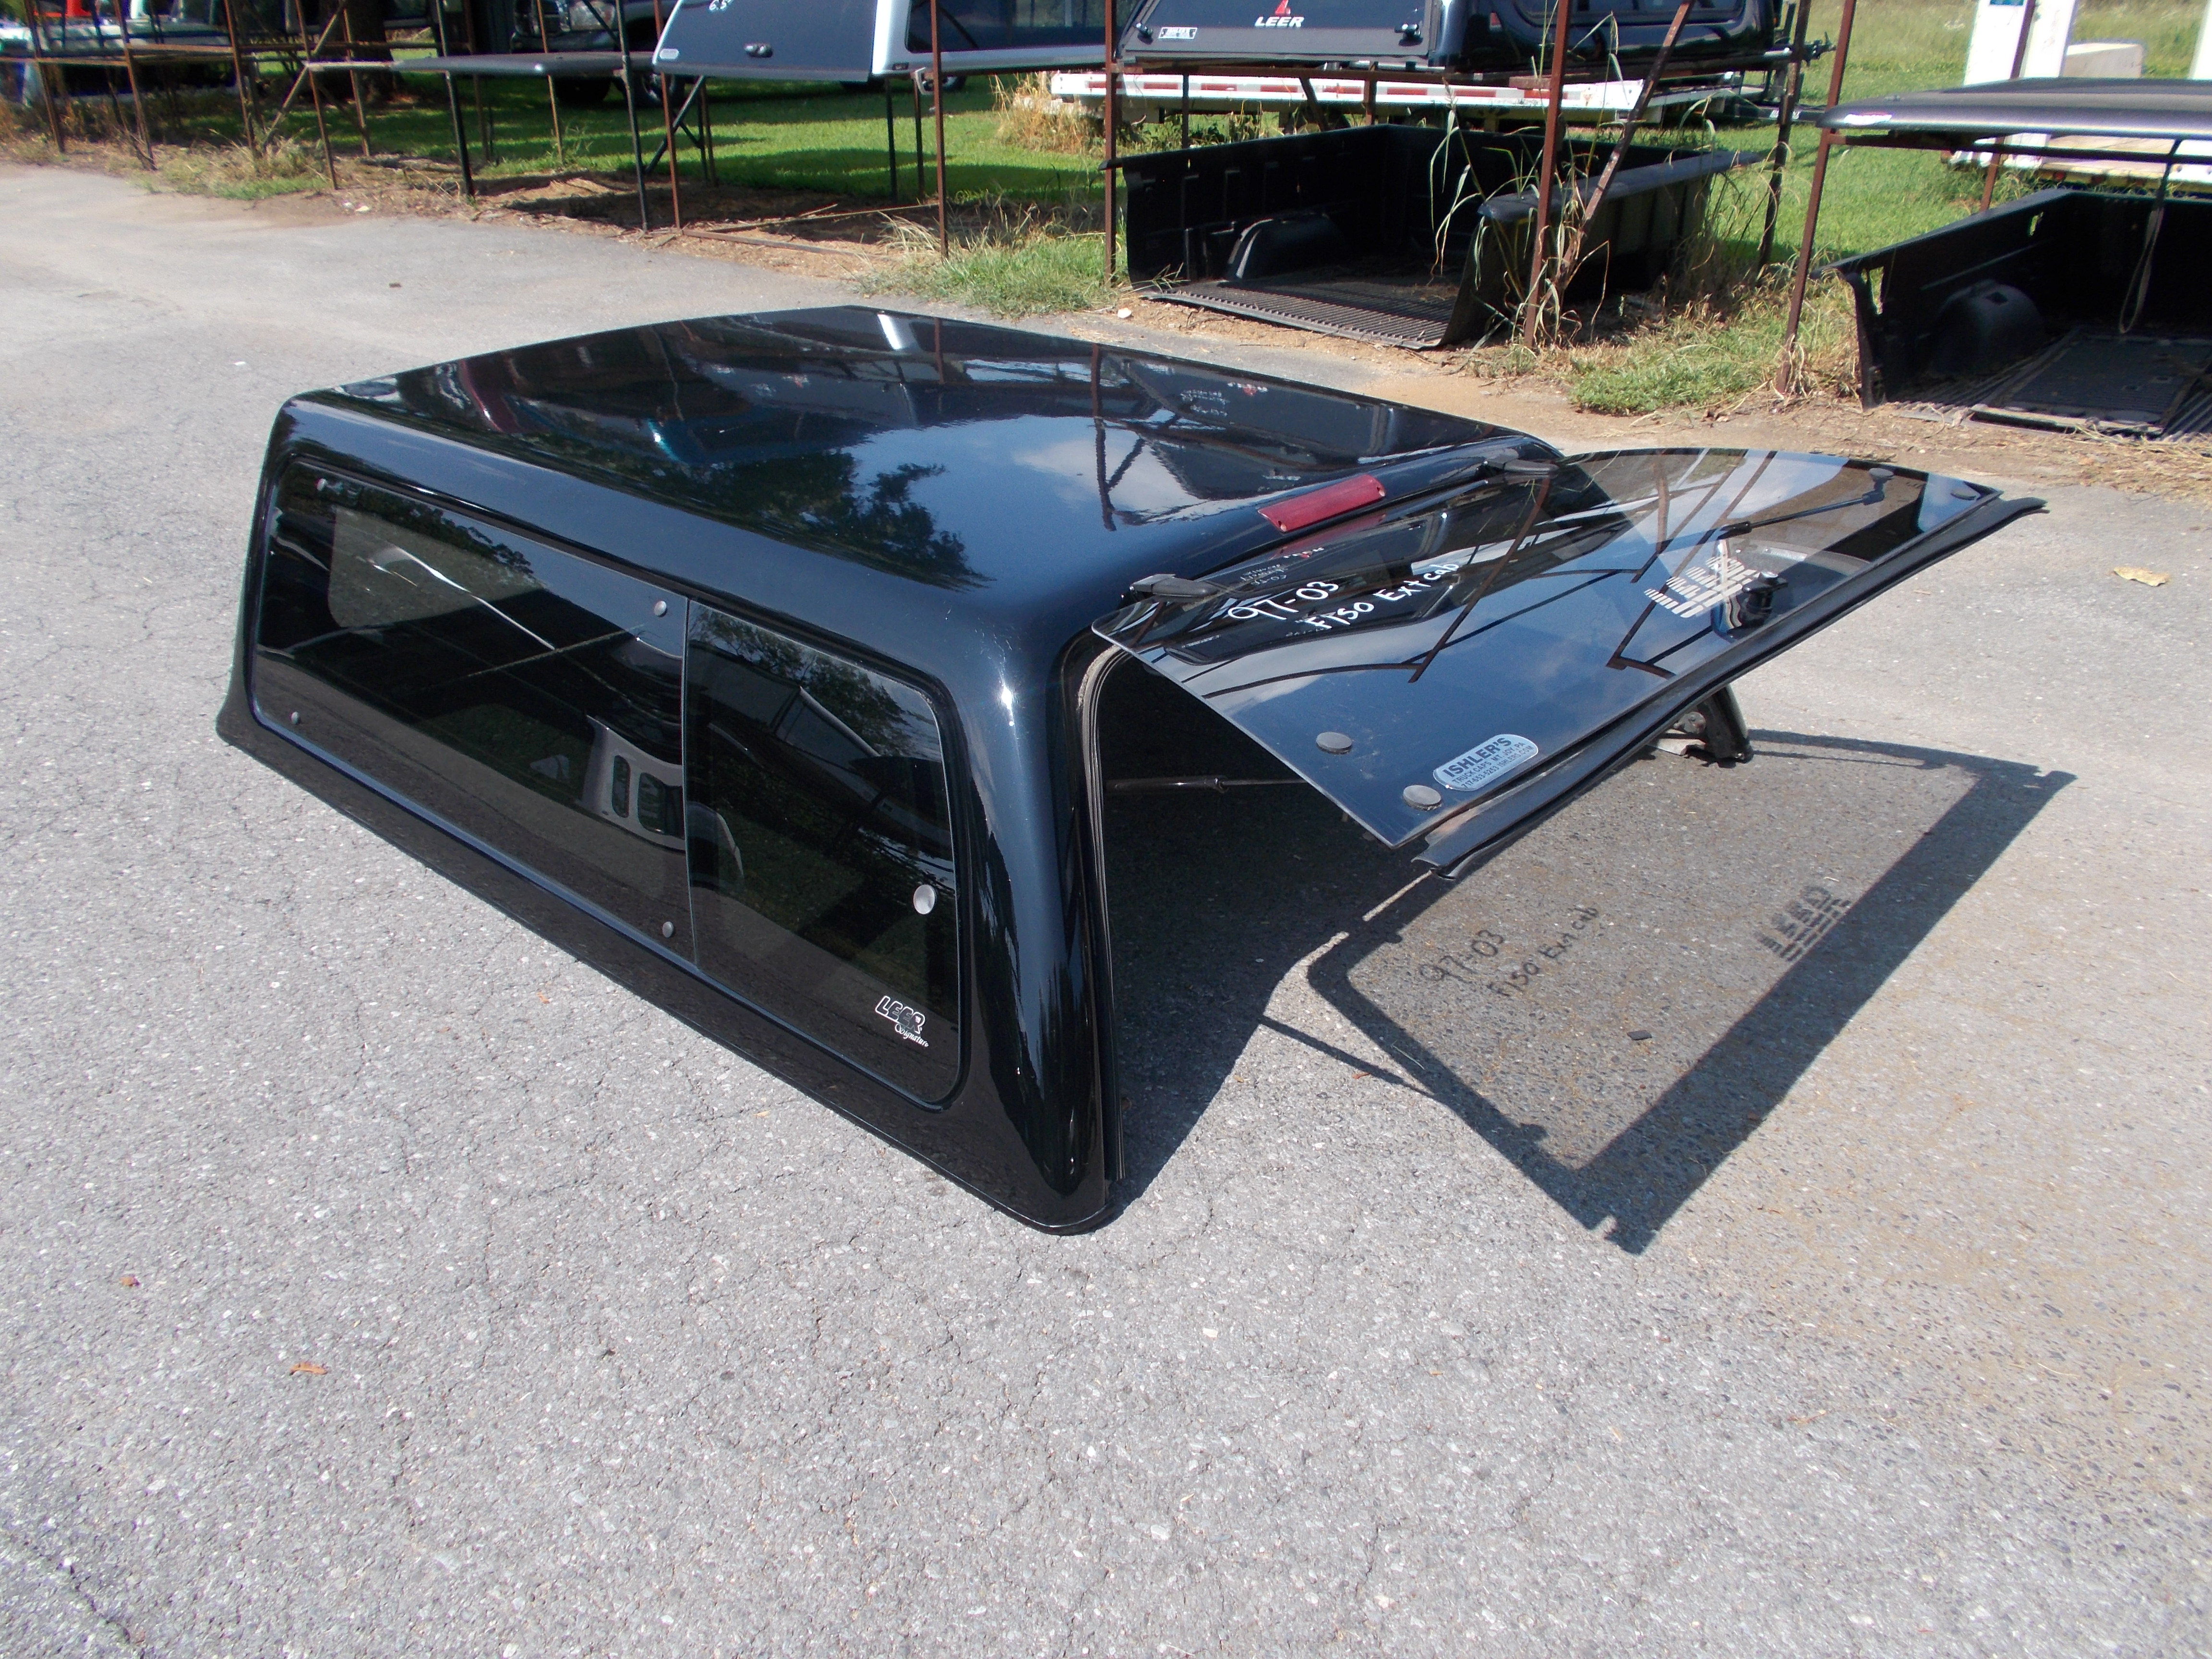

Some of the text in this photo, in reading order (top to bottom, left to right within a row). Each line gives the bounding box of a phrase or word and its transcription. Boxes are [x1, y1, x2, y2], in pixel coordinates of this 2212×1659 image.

[1254, 16, 1305, 27] LEER
[1228, 581, 1339, 620] 97-03
[1304, 602, 1374, 629] F150
[1372, 580, 1431, 601] Ext
[1442, 737, 1512, 778] ISHLER'S
[1452, 770, 1475, 784] TRUCK
[1474, 761, 1492, 773] CAPS
[1461, 745, 1534, 789] 717-653-5253 ISHLERS.COM
[875, 996, 926, 1034] LEER
[895, 1023, 929, 1047] Signature
